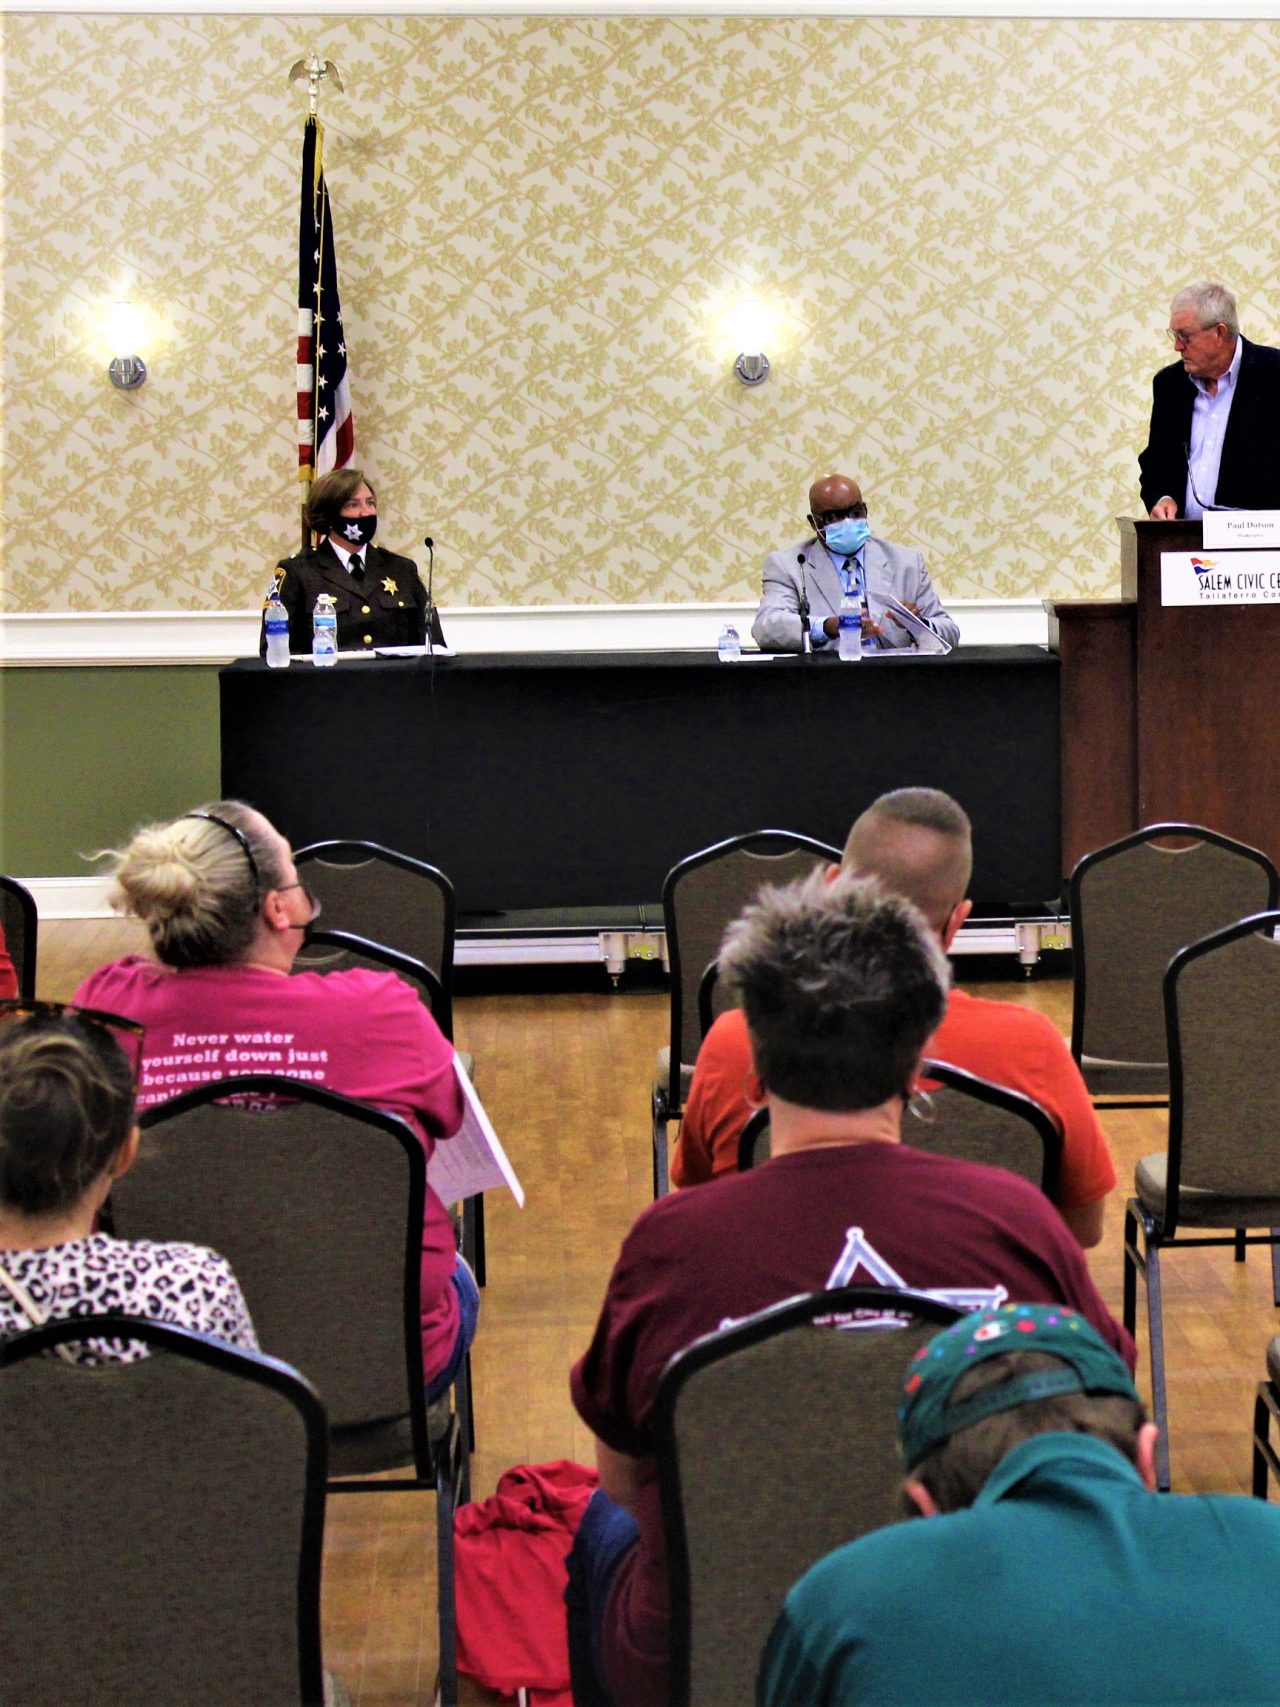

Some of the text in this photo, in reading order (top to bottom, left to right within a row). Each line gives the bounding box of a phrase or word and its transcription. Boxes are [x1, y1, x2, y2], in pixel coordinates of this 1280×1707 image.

[1227, 521, 1274, 529] Paul Dotson
[1198, 573, 1232, 591] SALEM
[1237, 572, 1265, 590] CIVIC
[1199, 592, 1257, 600] Taliaferro
[172, 1031, 295, 1047] Never water
[141, 1047, 329, 1072] yourself down just
[142, 1070, 222, 1086] because
